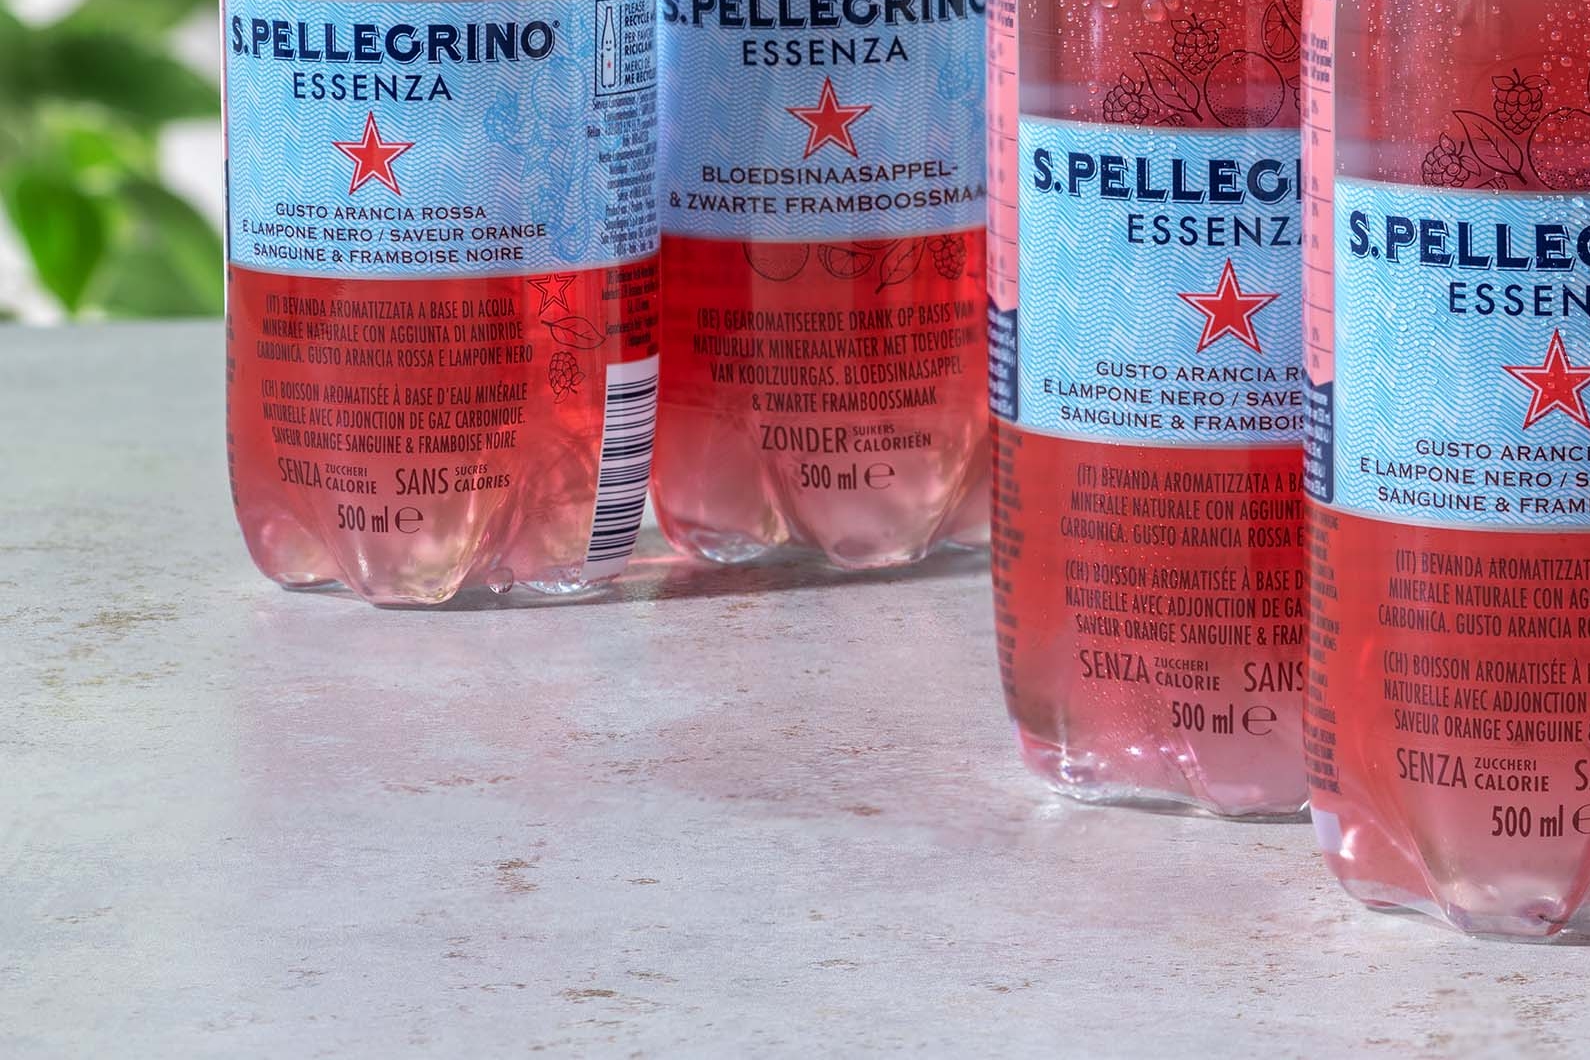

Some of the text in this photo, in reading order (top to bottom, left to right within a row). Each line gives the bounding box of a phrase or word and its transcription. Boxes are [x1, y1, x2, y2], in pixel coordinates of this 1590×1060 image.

[743, 36, 908, 66] ESSENZA
[294, 72, 452, 102] ESSENZA
[1034, 148, 1302, 205] S.PELLEG
[276, 203, 486, 220] GUSTO ARANCIA ROSSA
[670, 186, 984, 213] & ZWARTE FRAMBOOSSMAA
[242, 220, 546, 242] E LAMPONE NERO / SAVEUR ORANGE
[254, 243, 523, 263] SANGUINE & FRAMBOISE NOIRE
[1097, 362, 1167, 379] GUSTO
[1176, 367, 1277, 382] ARANCIA
[1043, 379, 1302, 406] E LAMPONE NERO / SAVE
[1062, 406, 1162, 428] SANGUINE
[1171, 415, 1184, 429] &
[760, 425, 894, 452] ZONDER SUIKERS
[854, 431, 931, 452] CALORIEËN
[1416, 440, 1491, 459] GUSTO
[278, 457, 367, 488] SENZA ZUCCHERI
[326, 477, 376, 494] CALORIE
[396, 464, 488, 495] SANS SUCRES
[455, 474, 510, 492] CALORIES
[801, 463, 856, 489] 500 ml
[1361, 457, 1369, 473] E
[1376, 460, 1475, 485] LAMPONE
[1486, 471, 1552, 487] NERO
[1560, 473, 1567, 487] /
[1379, 486, 1486, 511] SANGUINE
[1495, 497, 1509, 512] &
[1396, 549, 1416, 573] (IT)
[1421, 552, 1482, 578] BEVANDA
[1389, 578, 1449, 604] MINERALE
[1455, 583, 1527, 608] NATURALE
[1533, 587, 1563, 609] CON
[1379, 604, 1450, 633] CARBONICA.
[1456, 613, 1500, 636] GUSTO
[1507, 616, 1572, 639] ARANCIA
[1397, 748, 1536, 788] SENZA ZUCCHERI
[1475, 774, 1548, 791] CALORIE
[1492, 805, 1563, 837] 500 ml
